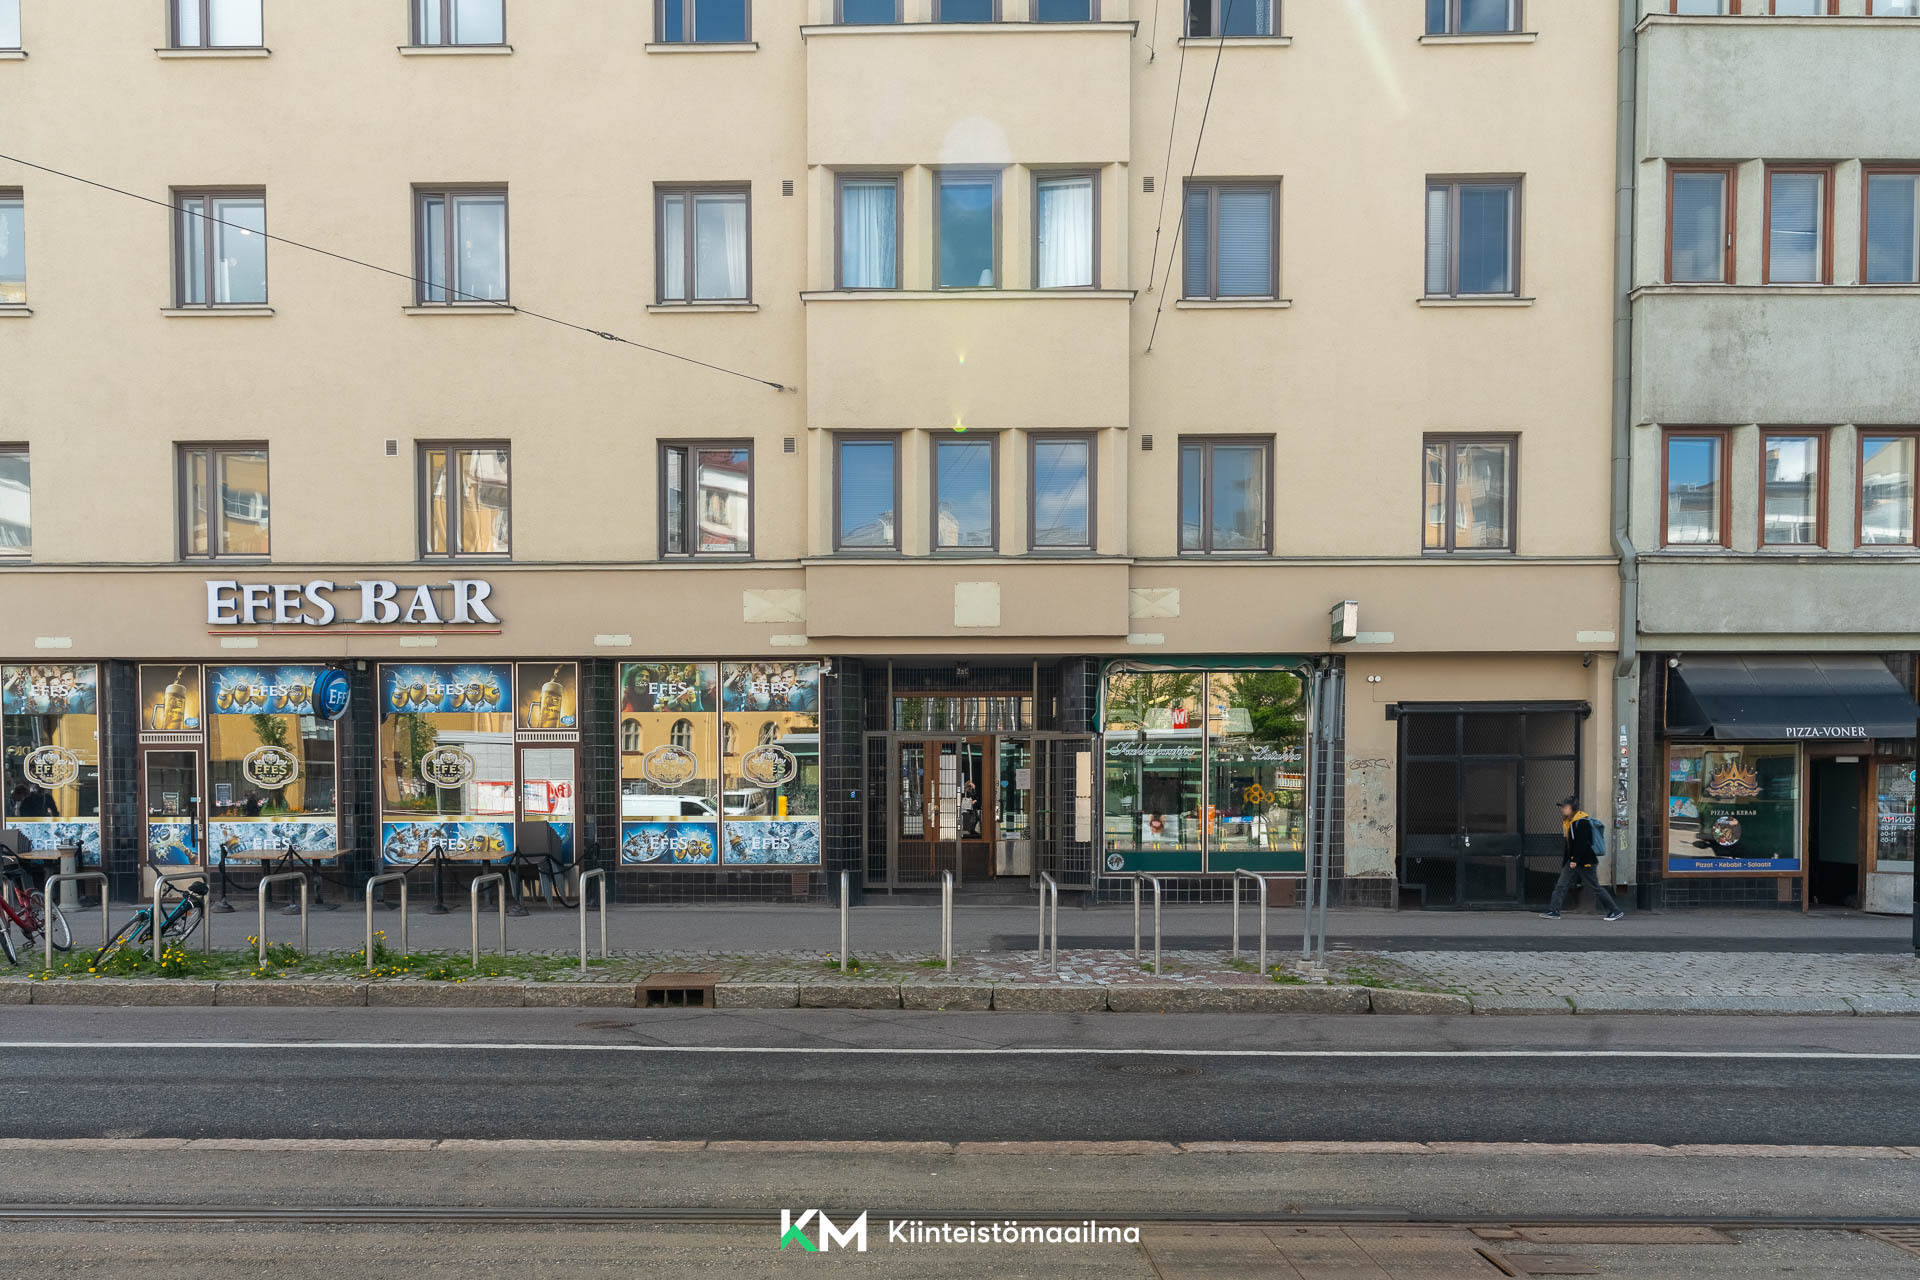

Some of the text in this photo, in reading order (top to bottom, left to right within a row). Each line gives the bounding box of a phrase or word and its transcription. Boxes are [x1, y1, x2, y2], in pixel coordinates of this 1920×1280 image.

[206, 580, 500, 626] EFES BAR
[30, 684, 69, 697] EFES
[249, 684, 288, 697] EFES
[426, 683, 465, 696] EFES
[648, 682, 688, 695] EFES
[751, 681, 790, 694] EFES
[1786, 726, 1868, 737] PIZZA-VONER
[254, 764, 287, 775] EFES
[433, 764, 465, 774] EFES
[35, 839, 61, 850] EFE
[252, 837, 291, 850] EFES
[428, 837, 467, 851] EFES
[650, 836, 688, 850] EFES
[752, 836, 790, 850] EFES
